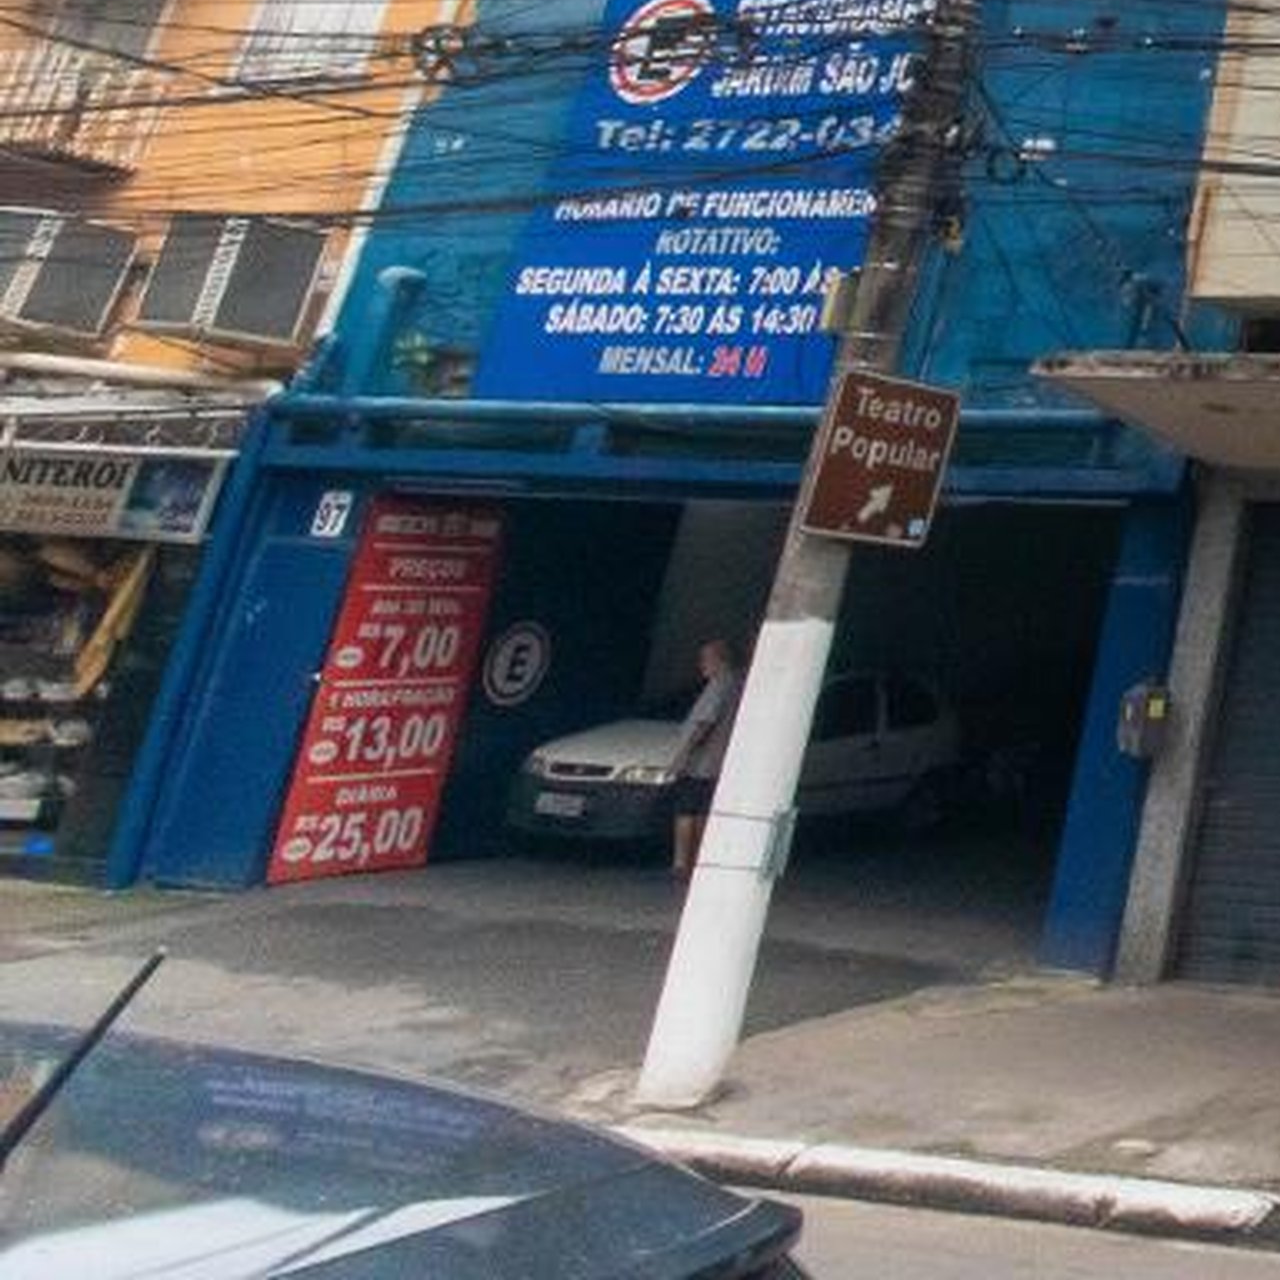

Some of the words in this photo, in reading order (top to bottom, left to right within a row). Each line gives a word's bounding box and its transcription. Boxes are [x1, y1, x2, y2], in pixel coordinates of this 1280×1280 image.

[819, 42, 880, 95] SÃO
[596, 119, 674, 152] Tel:
[655, 227, 782, 255] ROTATIVO:
[516, 266, 626, 295] SEGUNDA
[656, 266, 741, 294] SEXTA:
[749, 266, 800, 294] 7:00
[545, 296, 648, 334] SÁBADO:
[653, 304, 704, 334] 7:30
[752, 304, 816, 335] 14:30
[599, 345, 704, 375] MENSAL:
[856, 387, 941, 429] Teatro
[831, 426, 941, 471] Popular
[379, 624, 461, 677] 7,00
[345, 715, 447, 770] 13,00
[311, 806, 423, 867] 25,00
